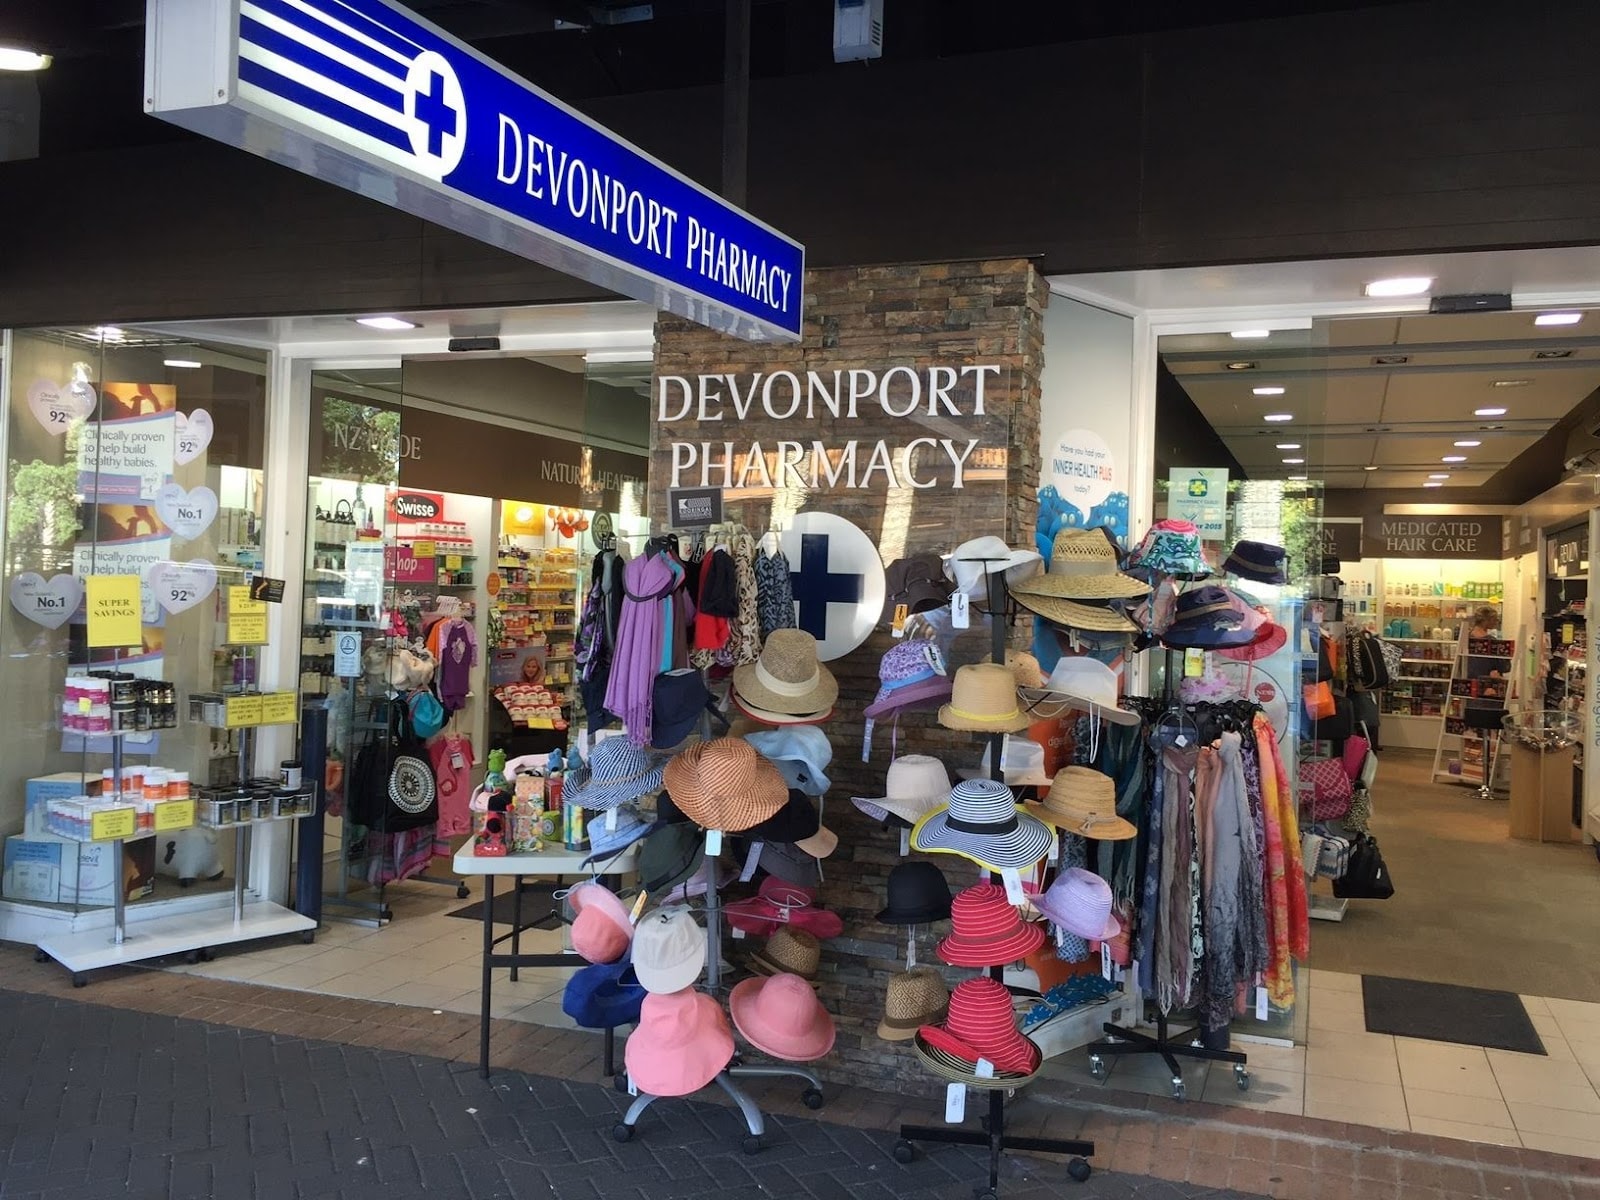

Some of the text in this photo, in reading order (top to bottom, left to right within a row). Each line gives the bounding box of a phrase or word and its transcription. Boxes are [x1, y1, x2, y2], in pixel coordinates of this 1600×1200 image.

[496, 112, 791, 313] DEVONPORT PHARMACY
[657, 365, 1001, 422] DEVONPORT
[84, 429, 165, 443] Clnically proven
[84, 443, 95, 453] to
[122, 442, 146, 455] build
[367, 428, 421, 460] MDE
[669, 437, 980, 489] PHARMACY
[1053, 459, 1073, 475] INNER
[1074, 461, 1098, 479] HEALTH
[541, 460, 596, 489] NATUR
[178, 508, 202, 520] No.1
[397, 497, 435, 517] Swisse
[1382, 522, 1482, 536] MEDICATED
[1386, 538, 1477, 552] HAIR CARE
[80, 550, 125, 565] Clnically
[37, 596, 65, 608] No.1
[98, 599, 130, 607] SUPER
[94, 609, 136, 618] SAVINGS
